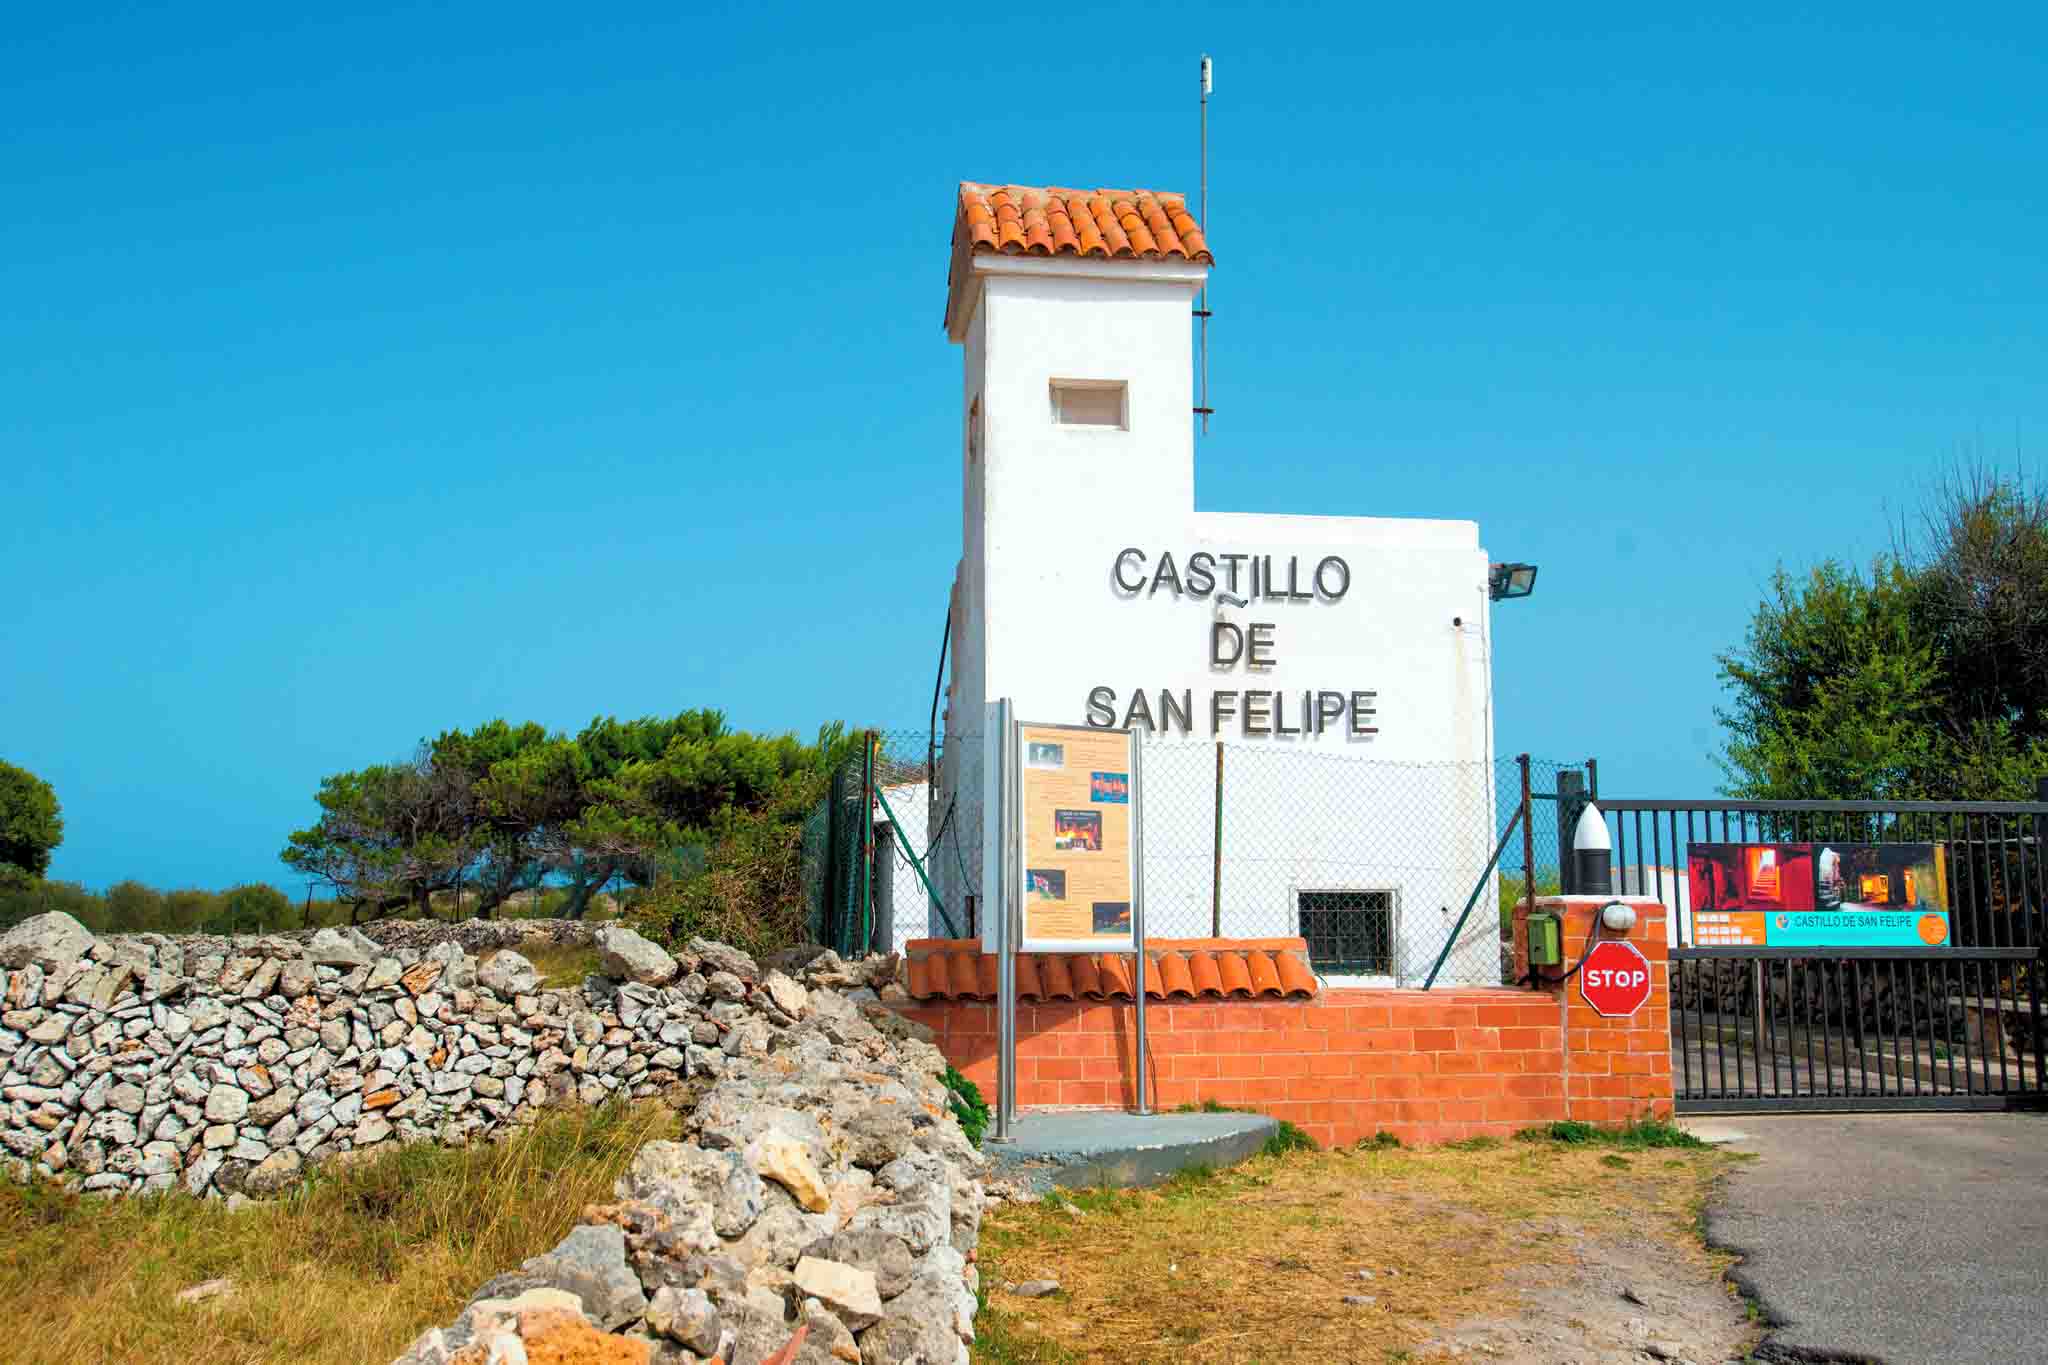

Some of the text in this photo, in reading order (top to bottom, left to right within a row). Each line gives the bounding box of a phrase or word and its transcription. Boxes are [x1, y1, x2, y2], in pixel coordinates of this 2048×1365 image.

[1113, 547, 1351, 600] CASTILLO
[1211, 621, 1277, 666] DE
[1086, 686, 1379, 735] SAN FELIPE
[1795, 915, 1912, 928] CASTILLO DE SAN FELIPE
[1587, 969, 1646, 988] STOP
